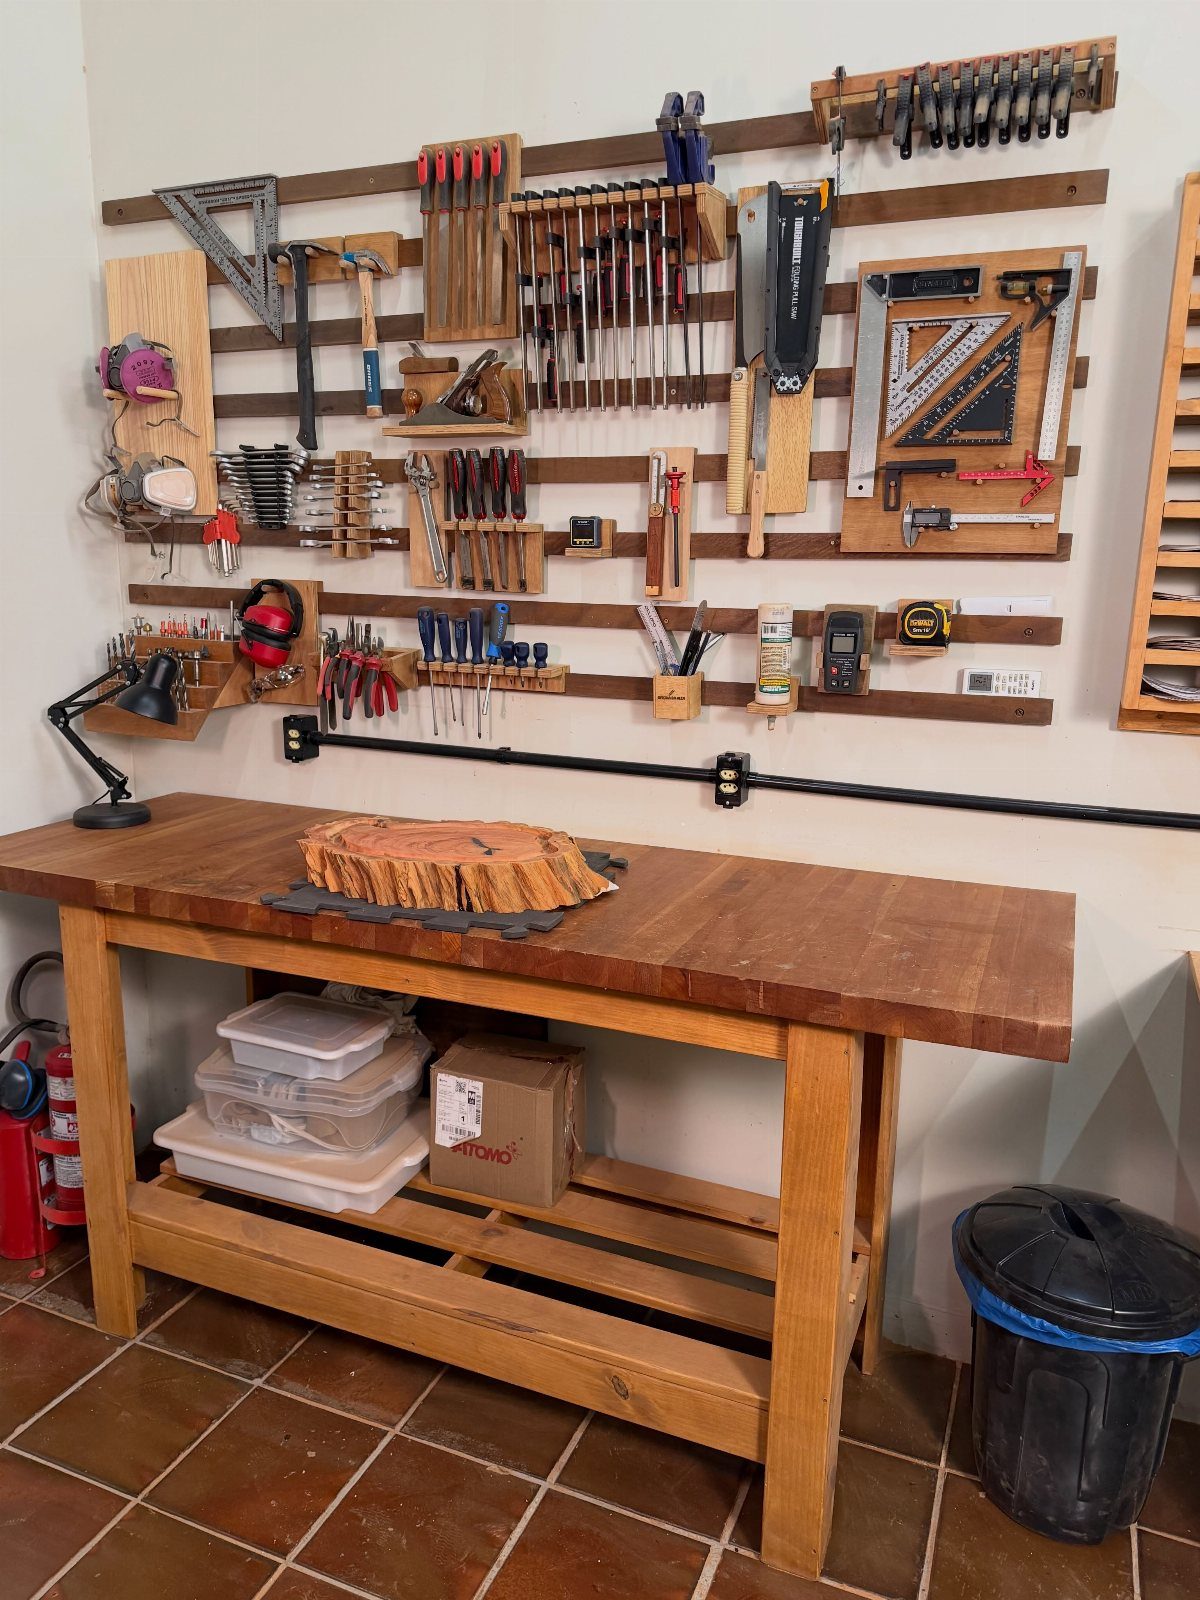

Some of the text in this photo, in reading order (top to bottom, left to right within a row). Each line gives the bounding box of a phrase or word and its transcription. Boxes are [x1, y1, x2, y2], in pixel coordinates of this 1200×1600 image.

[792, 216, 804, 265] TOUGHBUILT
[793, 265, 801, 290] FOLDING
[791, 291, 799, 306] PULL
[790, 306, 798, 320] SAW
